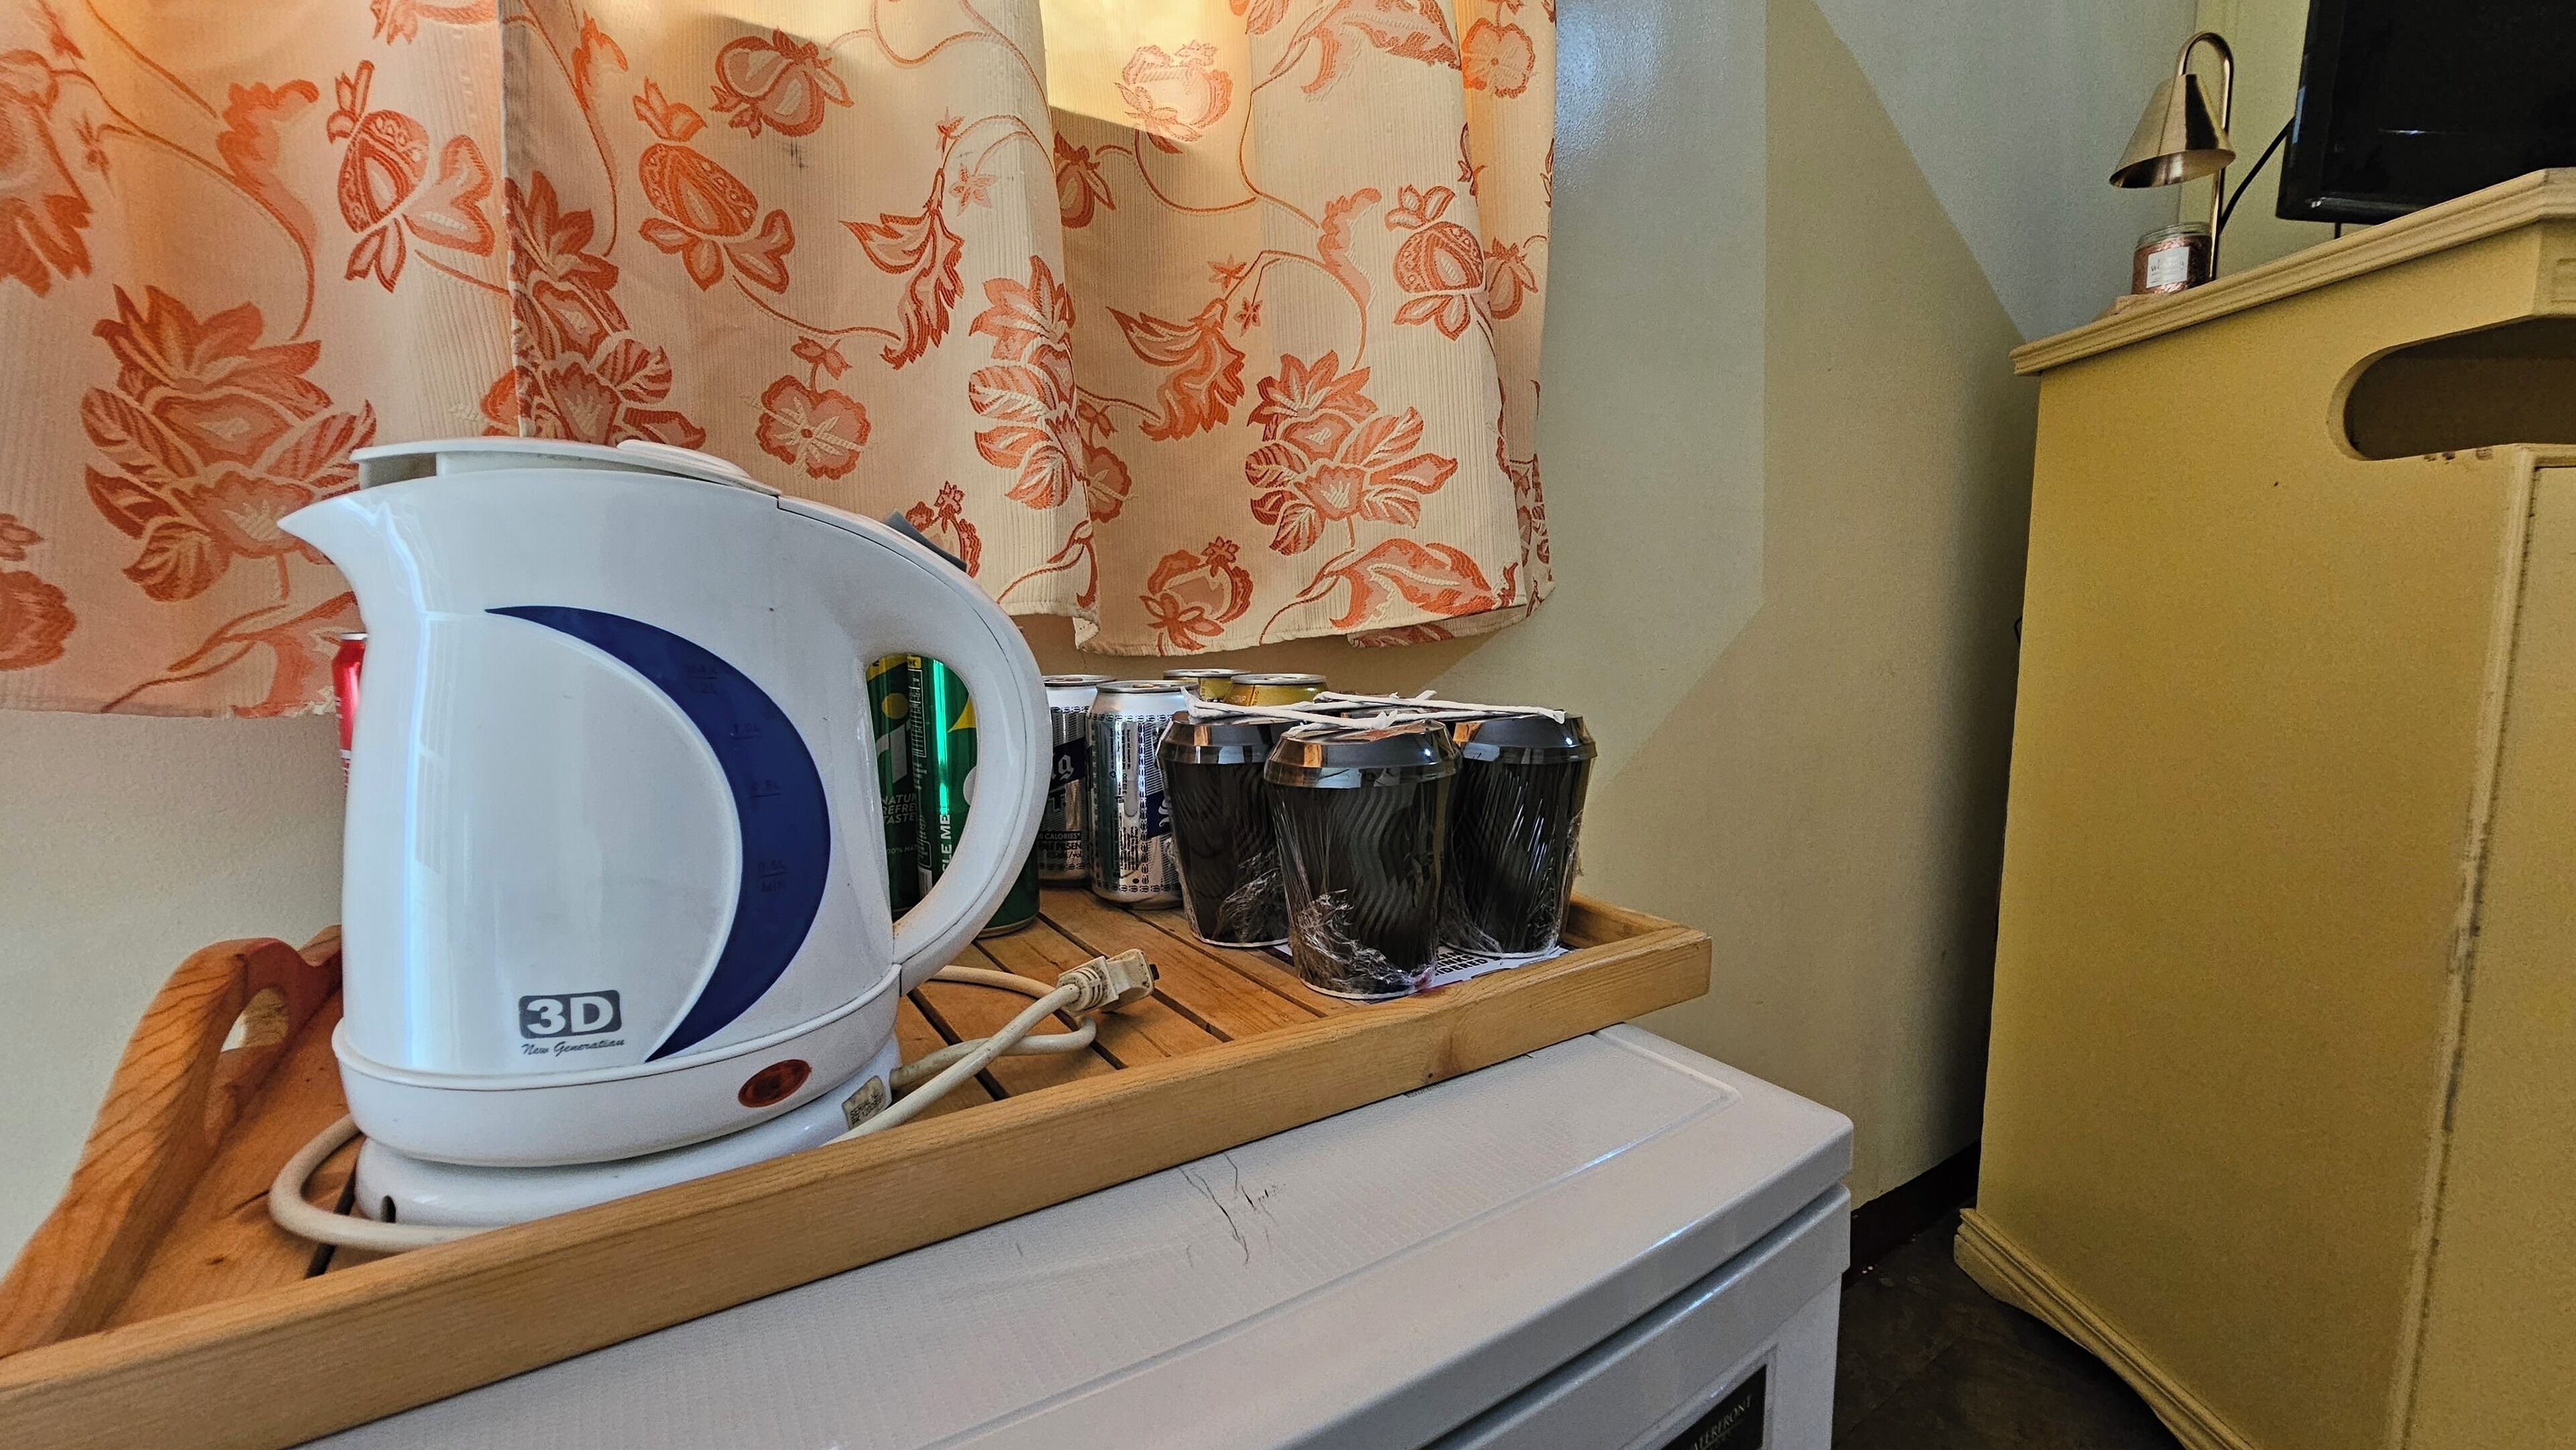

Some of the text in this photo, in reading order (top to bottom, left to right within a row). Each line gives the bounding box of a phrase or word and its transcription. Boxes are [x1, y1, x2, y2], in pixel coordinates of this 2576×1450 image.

[1436, 955, 1474, 968] INKS
[527, 996, 613, 1035] 3D
[522, 1039, 625, 1057] New Generation
